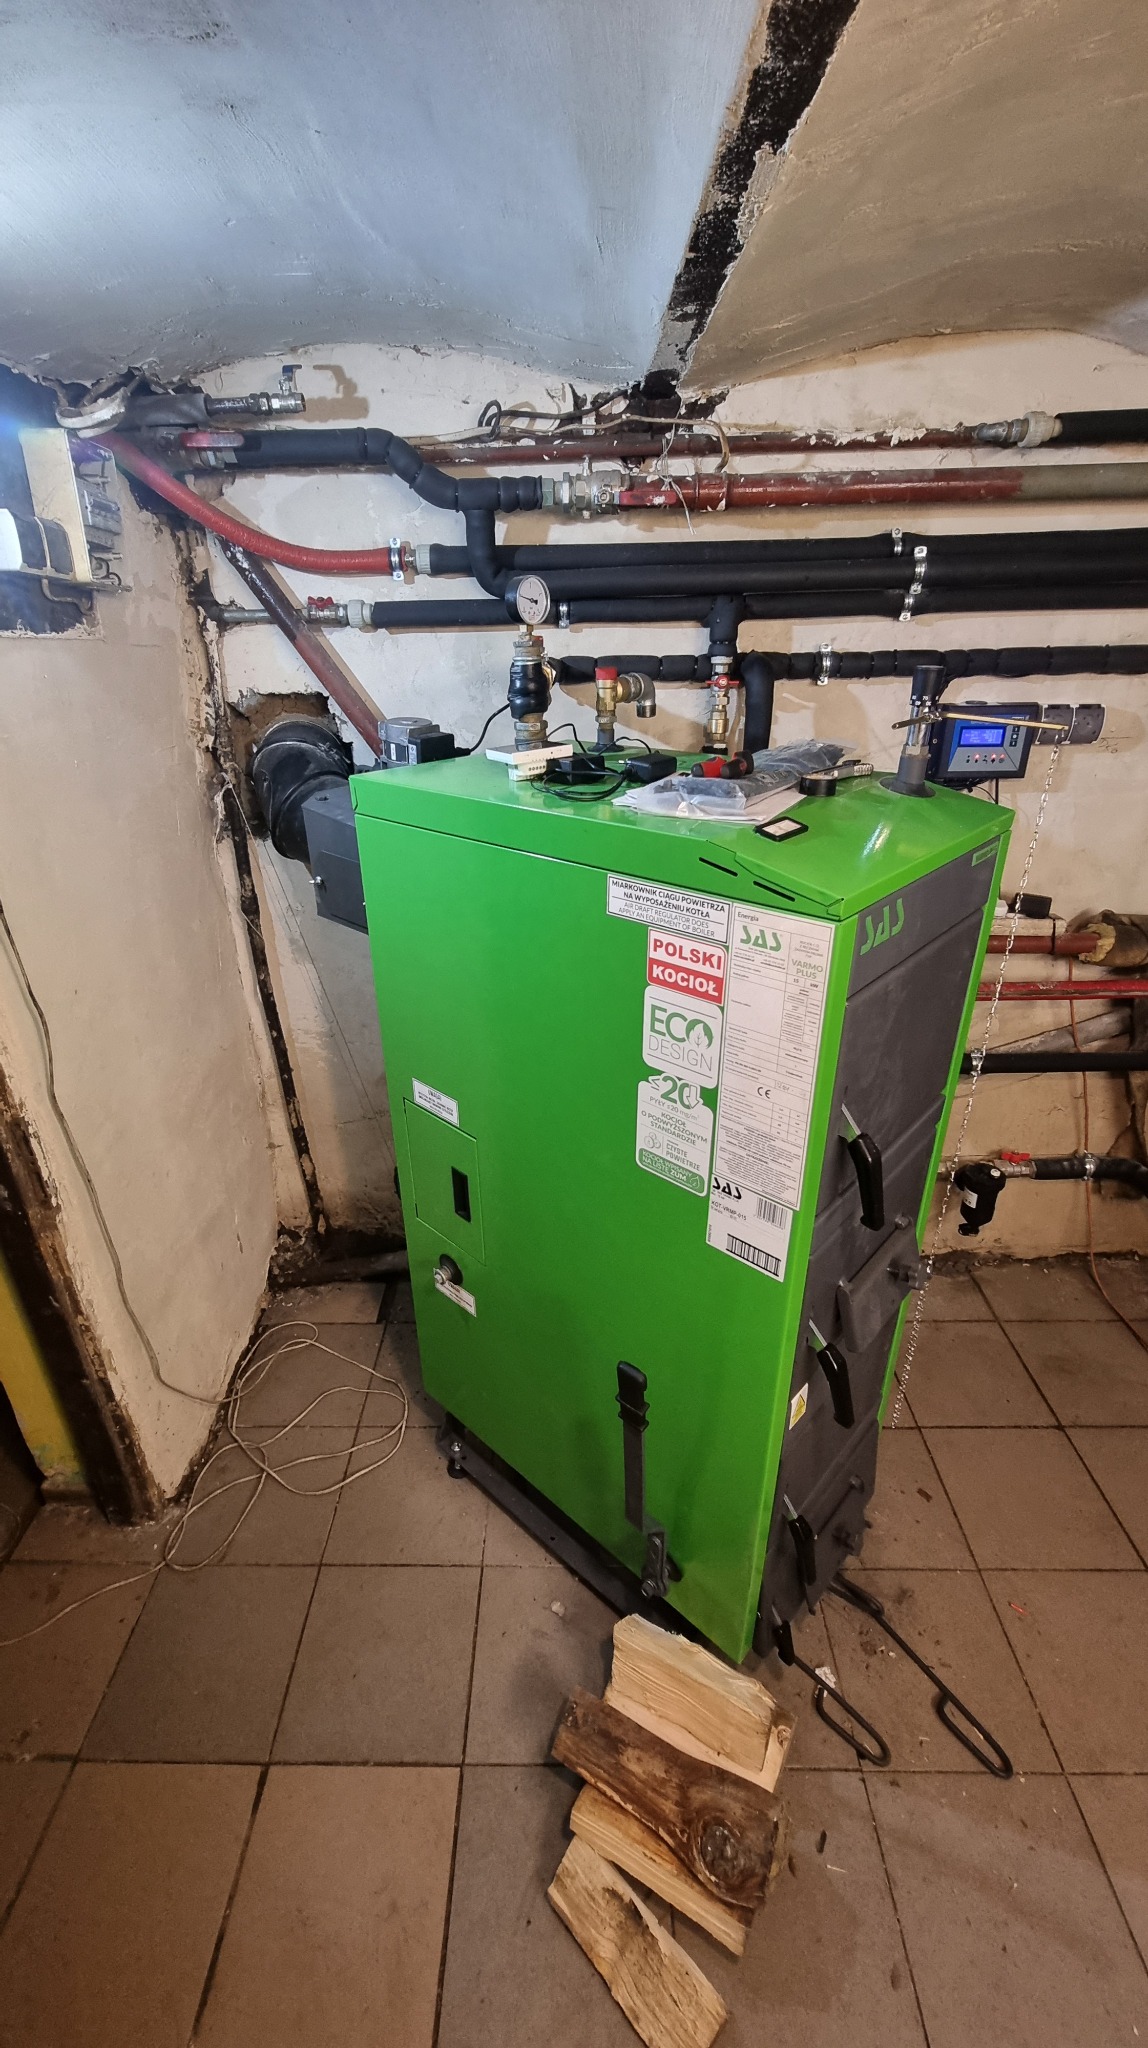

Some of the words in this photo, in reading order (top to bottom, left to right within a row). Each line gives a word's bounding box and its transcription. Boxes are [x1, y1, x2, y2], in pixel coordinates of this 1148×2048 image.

[611, 880, 657, 896] MIARKOWNIK
[658, 890, 680, 902] CIĄGU
[681, 896, 725, 912] POWIETRZA
[623, 891, 633, 899] NA
[634, 894, 685, 913] WYPOSAŻENIU
[685, 906, 710, 918] KOTŁA
[618, 907, 636, 916] APPLY
[645, 913, 681, 929] EQUIPMENT
[681, 922, 691, 930] OF
[691, 924, 715, 937] BOILER
[624, 901, 634, 909] AIR
[634, 903, 654, 914] DRAFT
[654, 907, 691, 924] REGULATOR
[691, 917, 709, 929] DOES
[737, 912, 759, 922] Energia
[860, 898, 905, 955] SAS
[740, 925, 782, 952] SAS
[653, 938, 722, 970] POLSKI
[791, 958, 824, 972] VARMO
[652, 965, 720, 997] KOCIOŁ
[796, 968, 817, 979] PLUS
[650, 1004, 714, 1049] ECO
[648, 1034, 713, 1072] DESIGN
[649, 1096, 666, 1107] PYŁY
[648, 1112, 708, 1144] PODWYŻSZONYM
[650, 1120, 697, 1146] STANDARDZIE
[661, 1112, 687, 1128] KOCIOŁ
[666, 1143, 688, 1158] CZYSTE
[666, 1151, 700, 1172] POWIETRZE
[670, 1171, 687, 1182] ZUM
[712, 1177, 742, 1200] SAS
